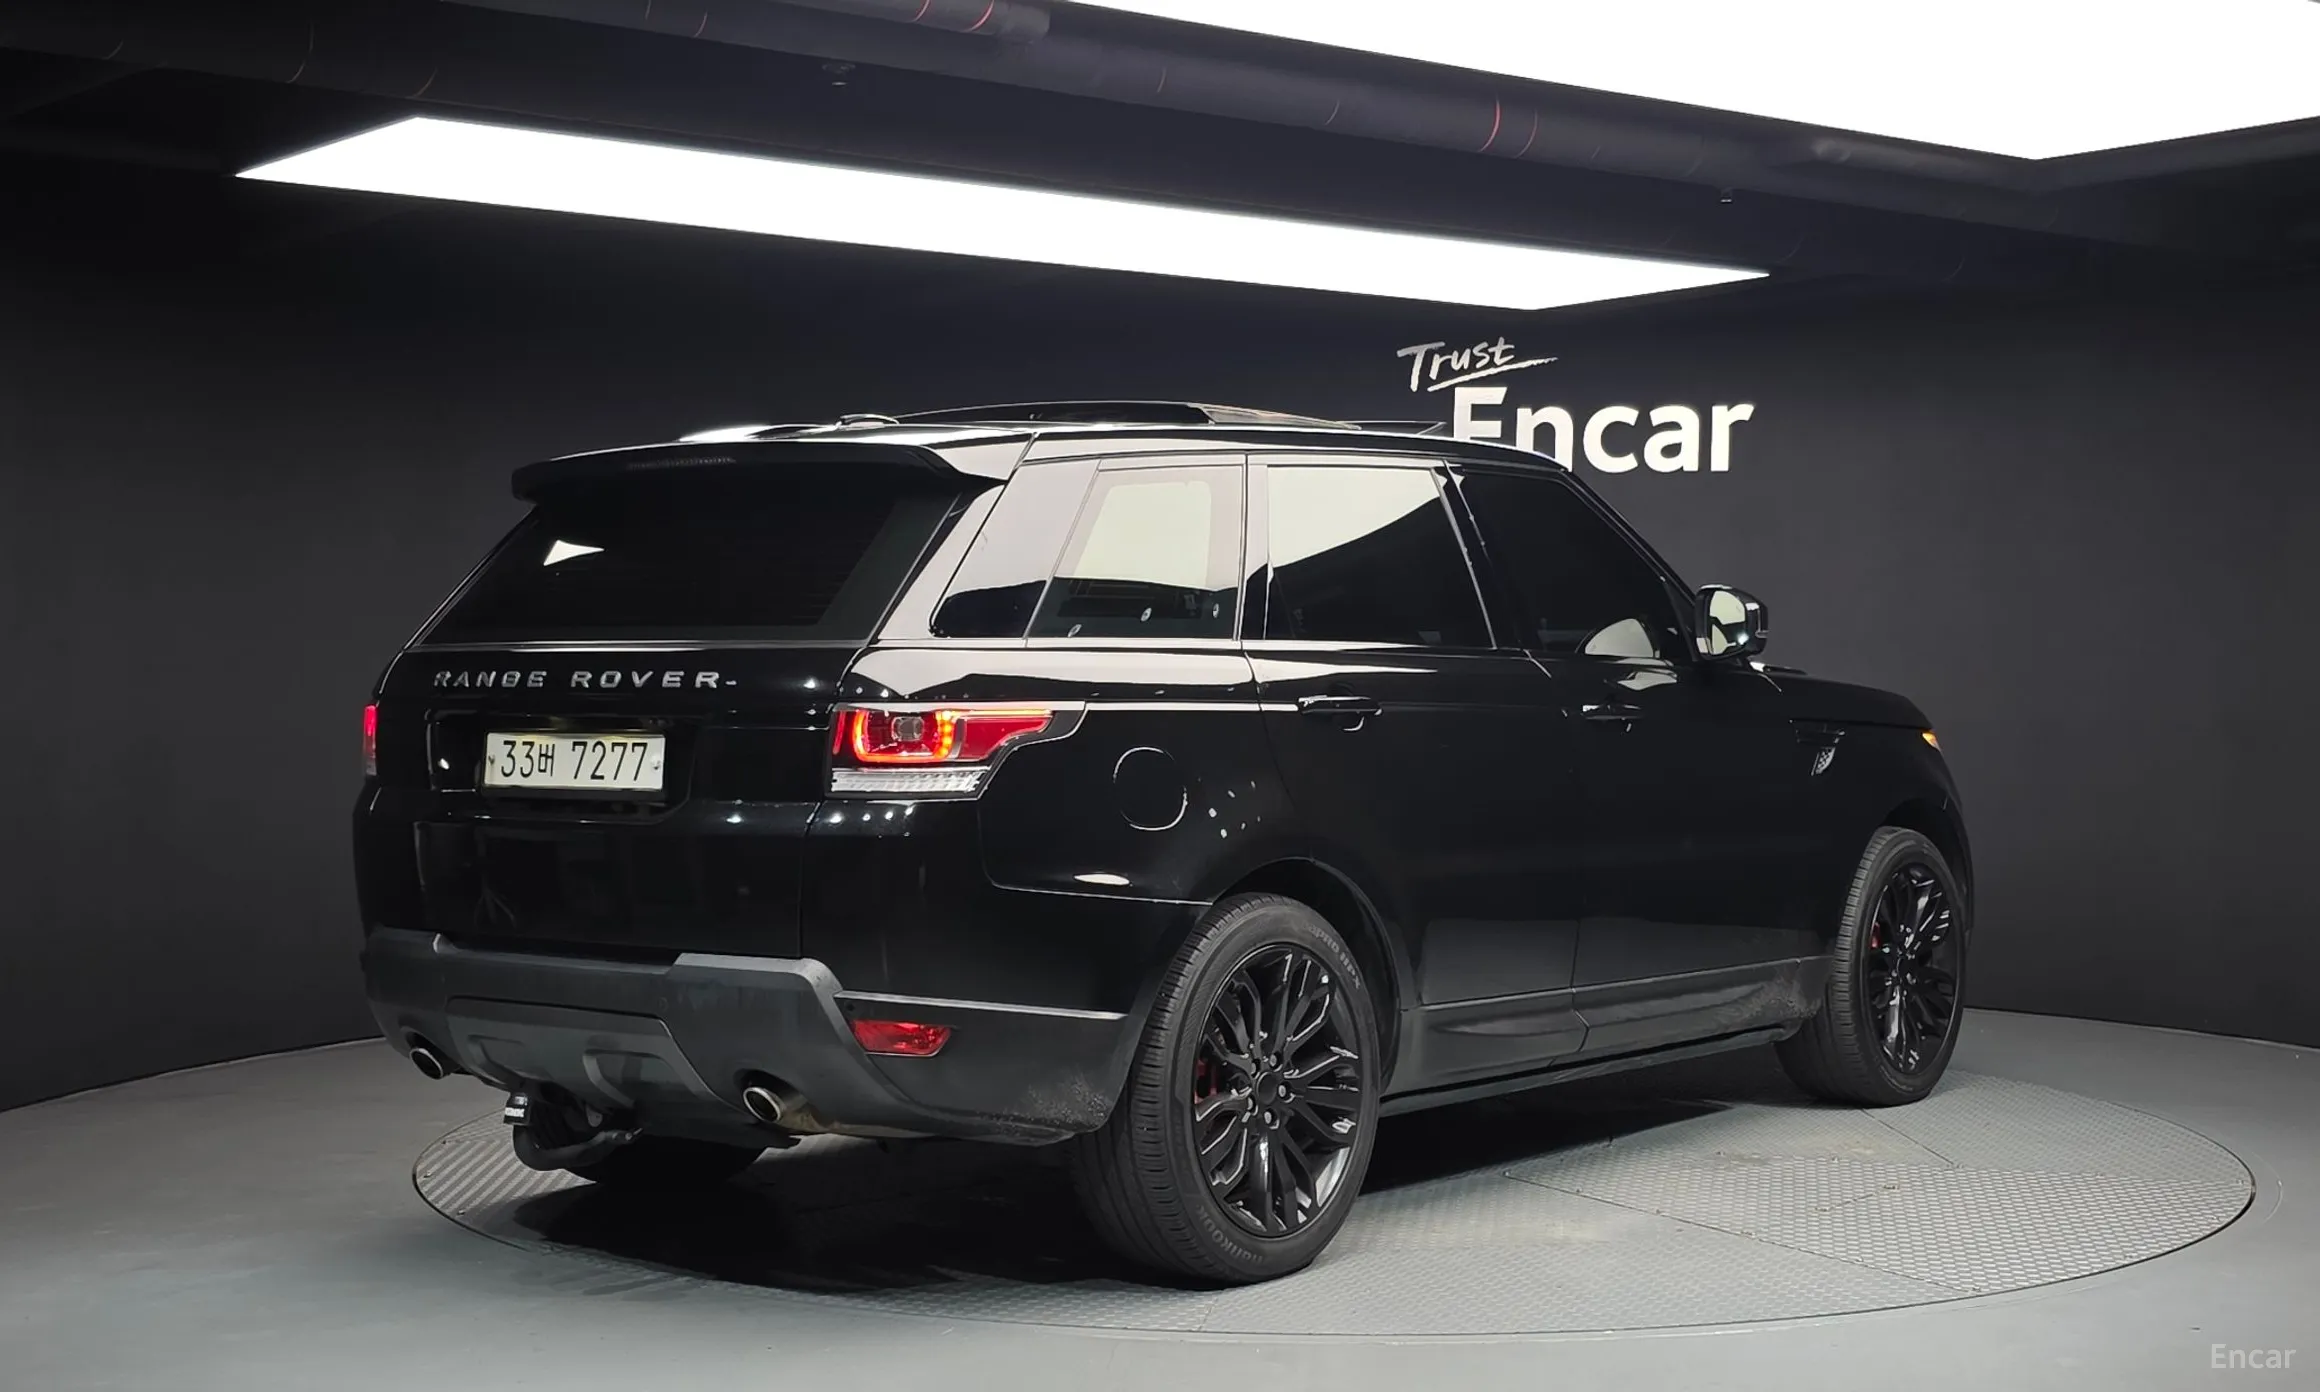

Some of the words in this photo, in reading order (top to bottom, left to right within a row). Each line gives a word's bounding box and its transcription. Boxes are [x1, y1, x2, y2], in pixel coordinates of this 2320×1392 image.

[1397, 337, 1516, 392] Trust
[1453, 386, 1755, 473] Encar
[434, 671, 547, 688] RANGE
[570, 671, 720, 688] ROVER
[501, 740, 555, 778] 33버
[572, 741, 648, 781] 7277
